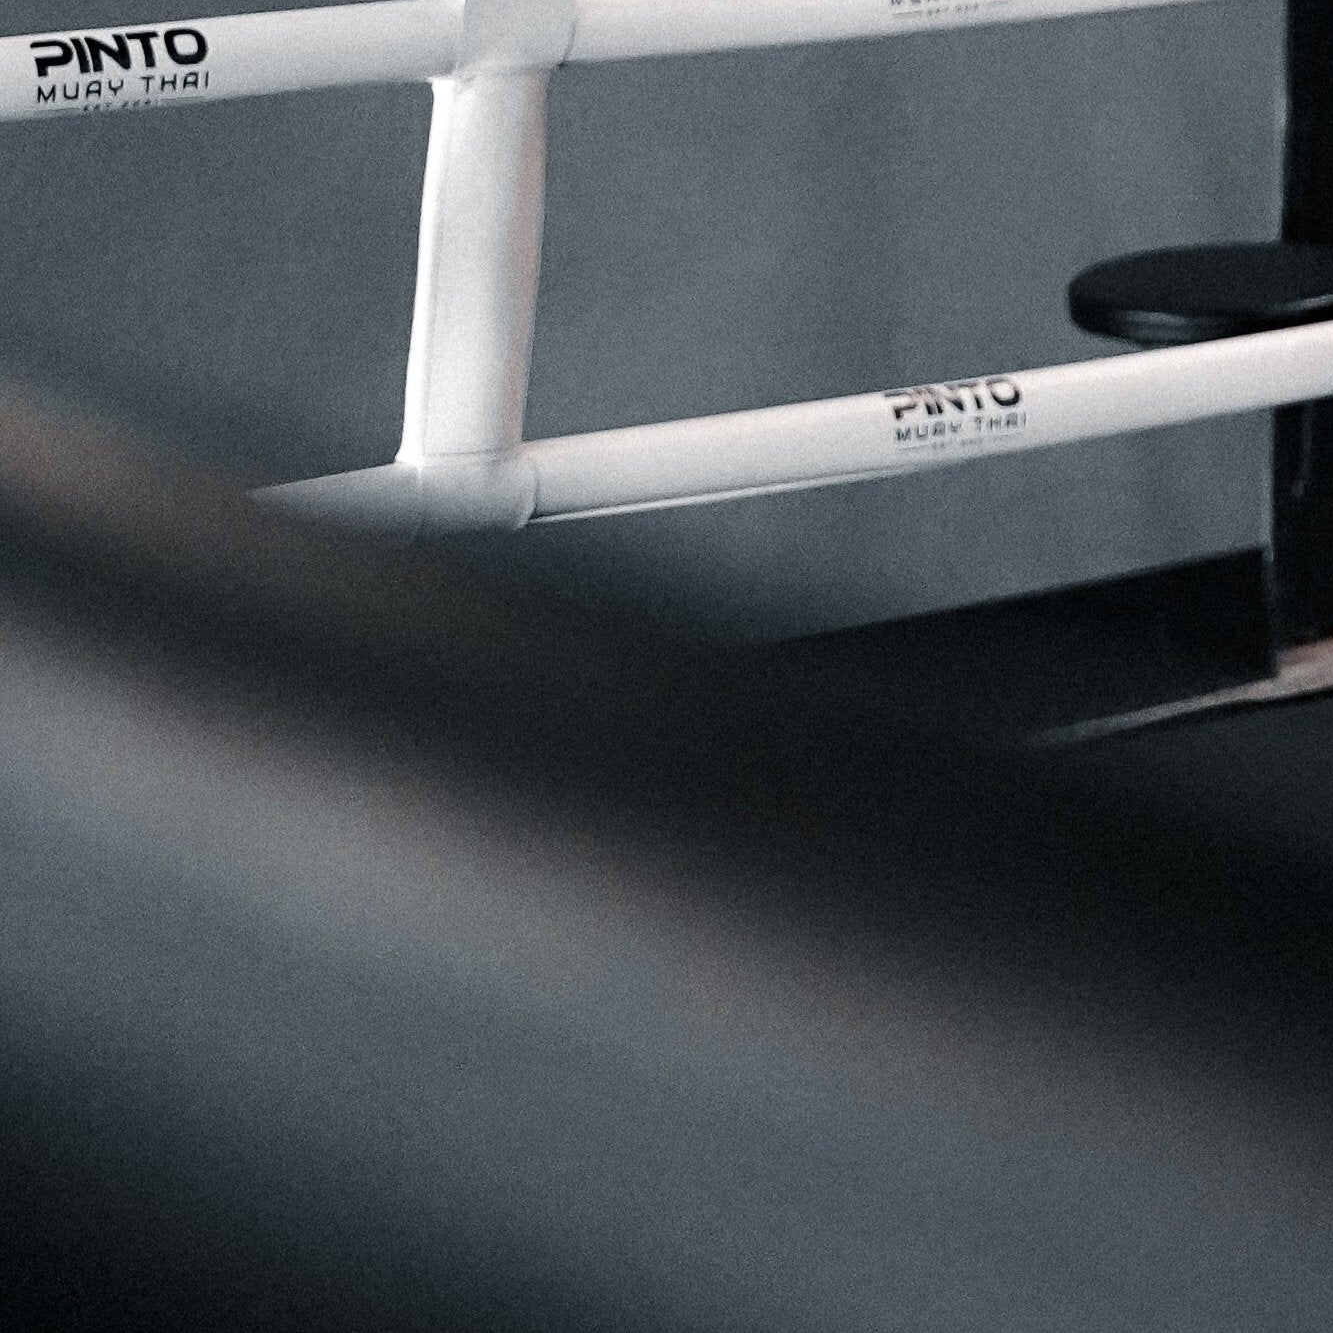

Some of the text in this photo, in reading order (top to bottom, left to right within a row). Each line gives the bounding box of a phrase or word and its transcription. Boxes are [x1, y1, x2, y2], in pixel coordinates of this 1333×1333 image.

[29, 27, 209, 78] PINTO
[36, 70, 210, 104] MUAY THAI
[883, 375, 1023, 420] PINTO
